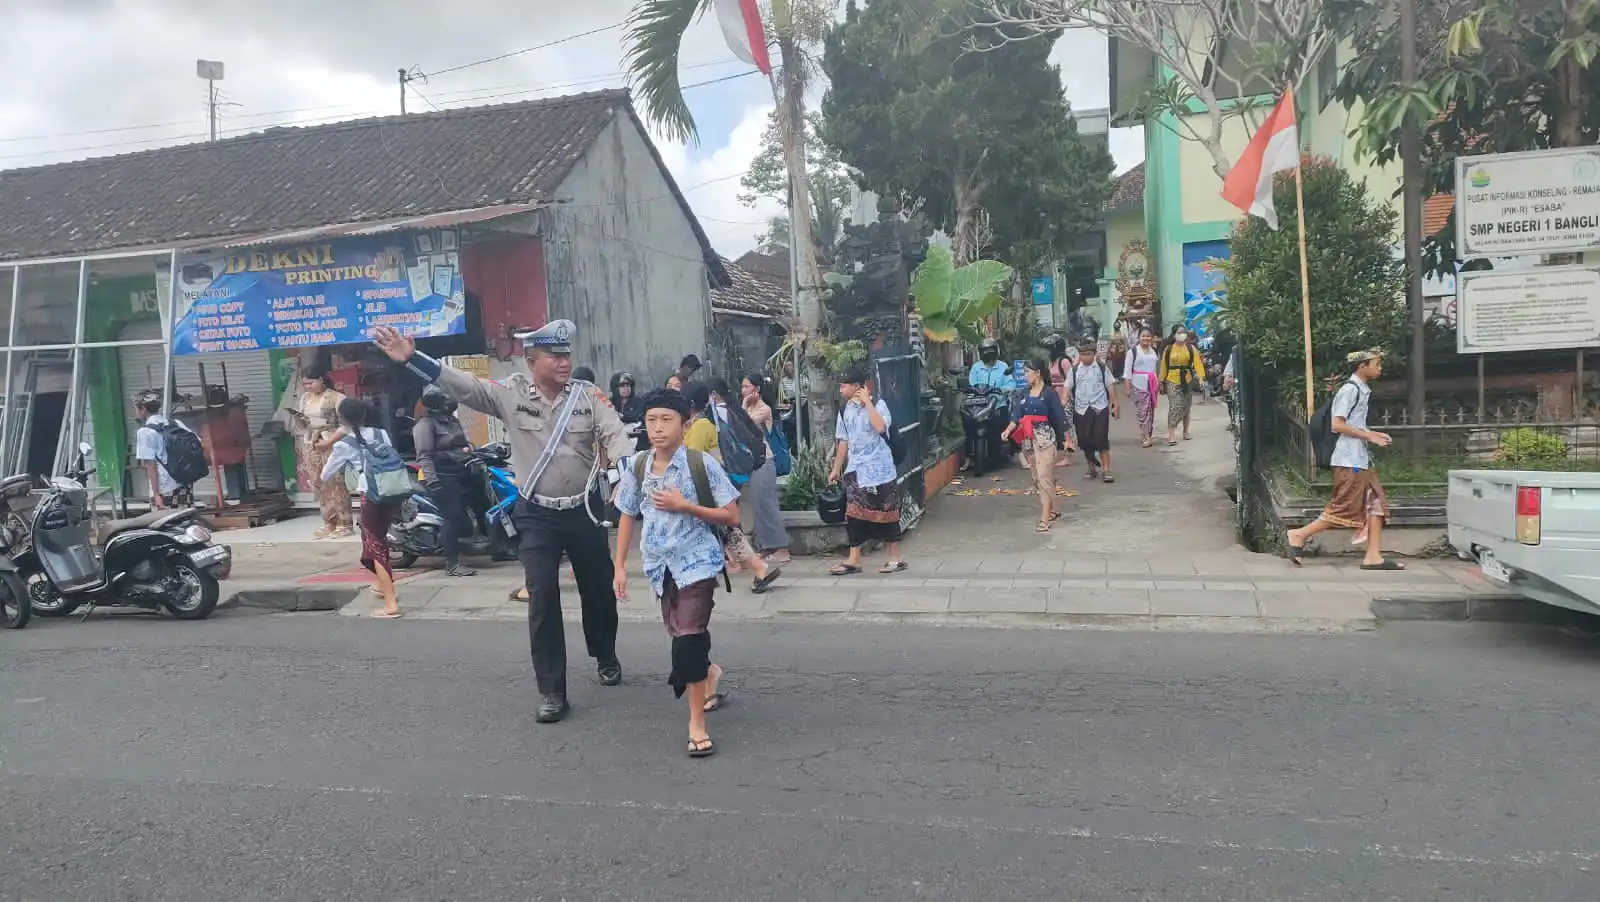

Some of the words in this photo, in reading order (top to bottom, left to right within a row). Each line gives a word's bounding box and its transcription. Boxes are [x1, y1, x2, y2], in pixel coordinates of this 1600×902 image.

[1467, 193, 1488, 203] PUSAT
[1490, 189, 1526, 201] INFORMASI
[1528, 186, 1567, 198] KONSELING
[1573, 183, 1600, 195] REMAJA
[1470, 223, 1494, 236] SMP
[1497, 219, 1541, 233] NEGERI
[1544, 219, 1550, 230] 1
[1555, 215, 1599, 229] BANGLI
[225, 244, 335, 274] DEKNI
[285, 265, 376, 285] PRINTING
